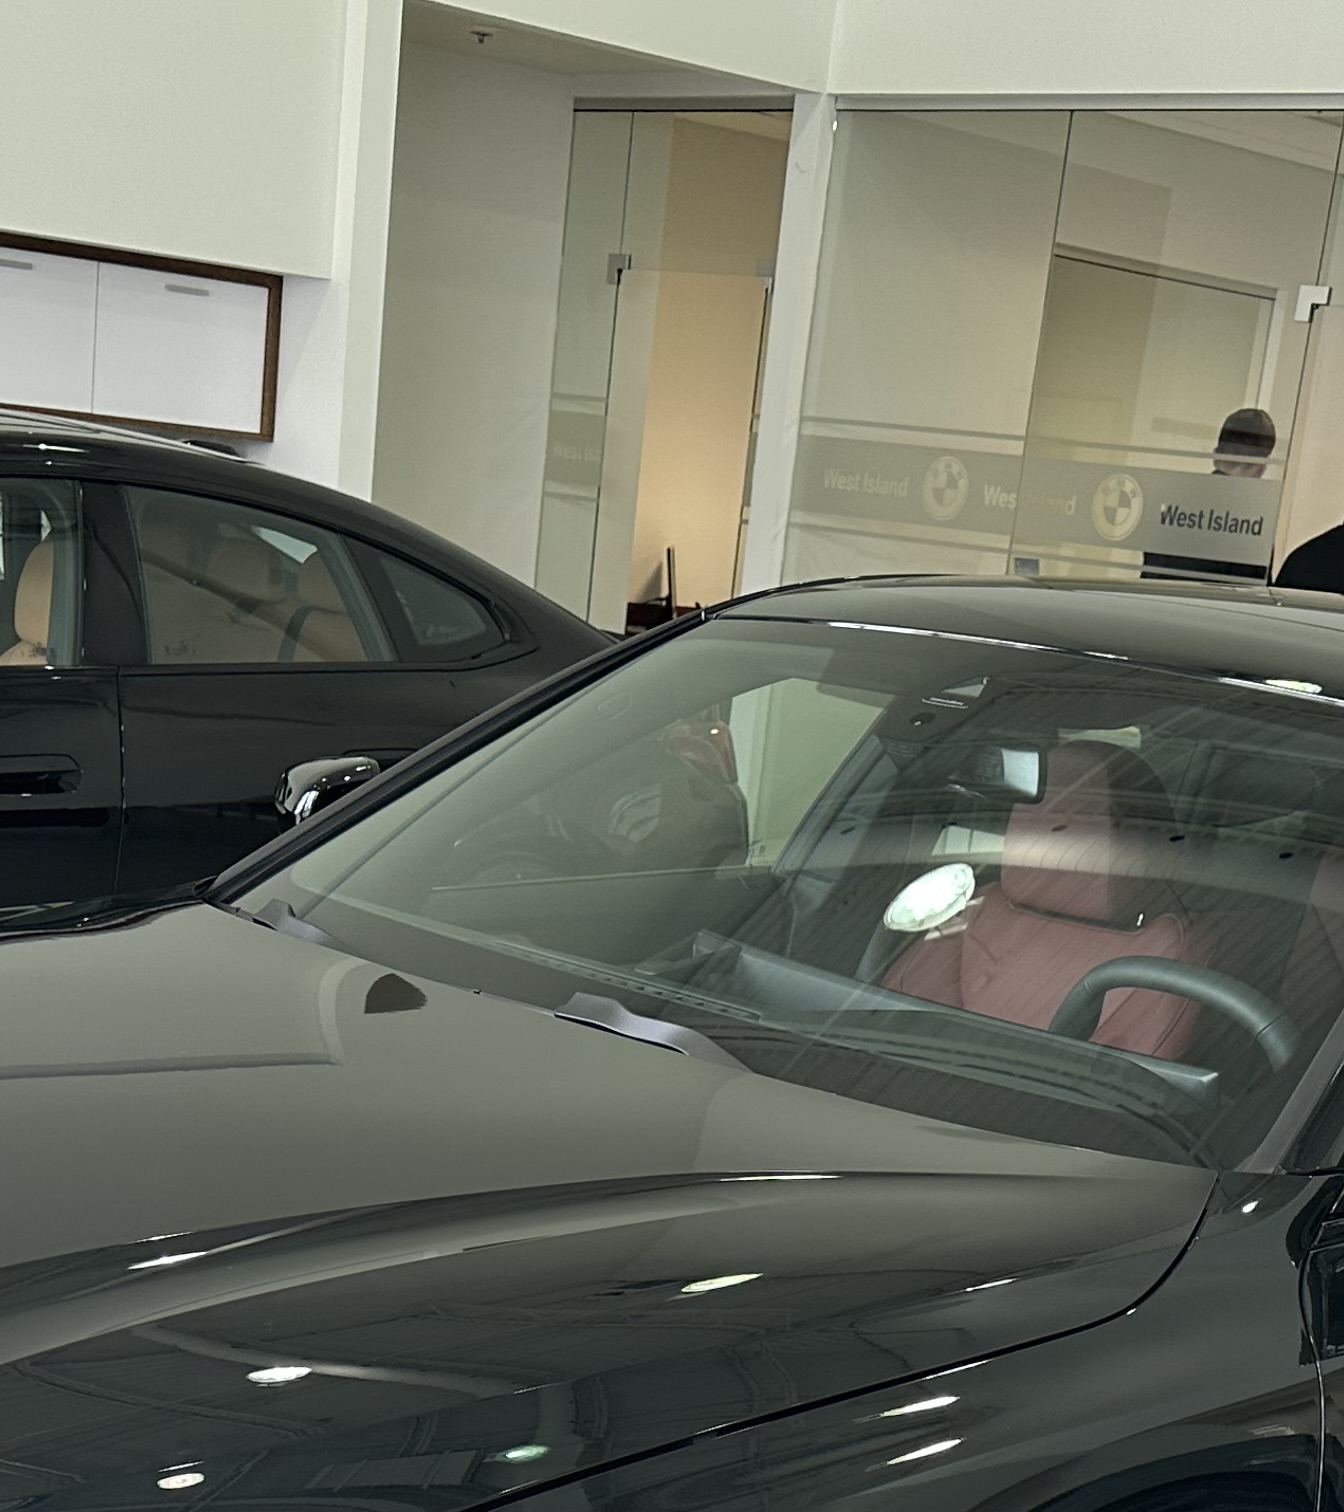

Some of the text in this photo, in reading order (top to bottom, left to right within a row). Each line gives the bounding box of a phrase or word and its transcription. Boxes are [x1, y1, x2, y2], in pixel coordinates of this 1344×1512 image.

[824, 469, 909, 497] West Island
[984, 483, 1017, 510] Wes
[1160, 503, 1264, 537] West Island
